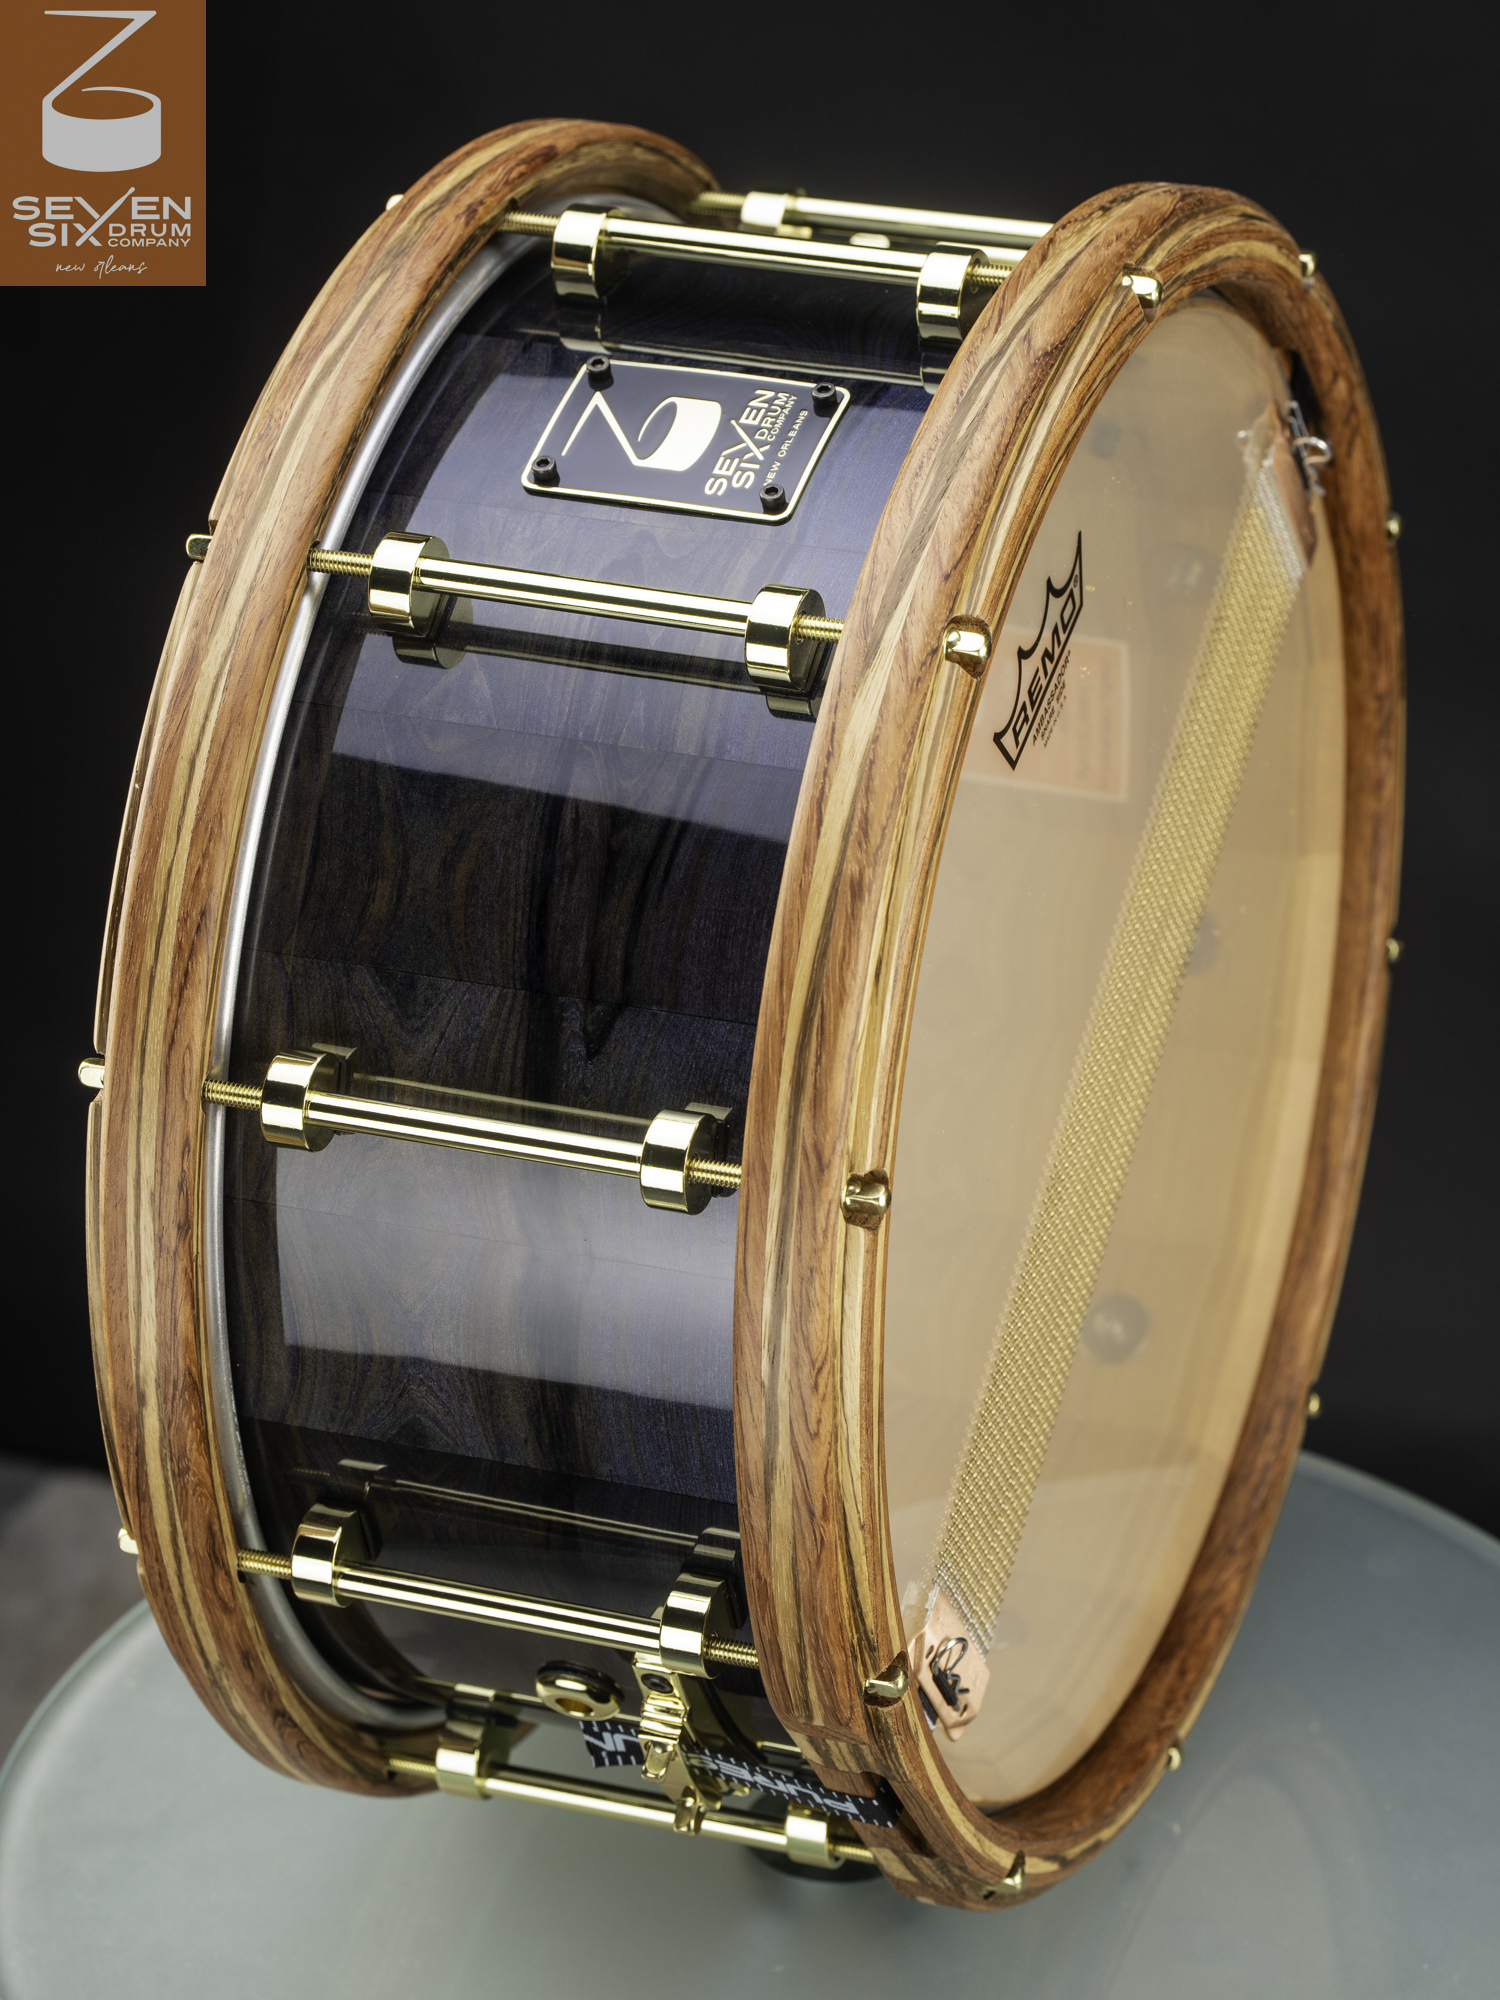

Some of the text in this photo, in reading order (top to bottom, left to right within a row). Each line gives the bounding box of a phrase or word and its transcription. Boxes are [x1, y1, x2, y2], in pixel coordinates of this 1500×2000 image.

[754, 392, 790, 440] DRUM
[767, 394, 797, 441] COMPANY
[778, 409, 809, 457] ORLEANS
[704, 389, 776, 496] SEVEN
[731, 444, 771, 489] SIX
